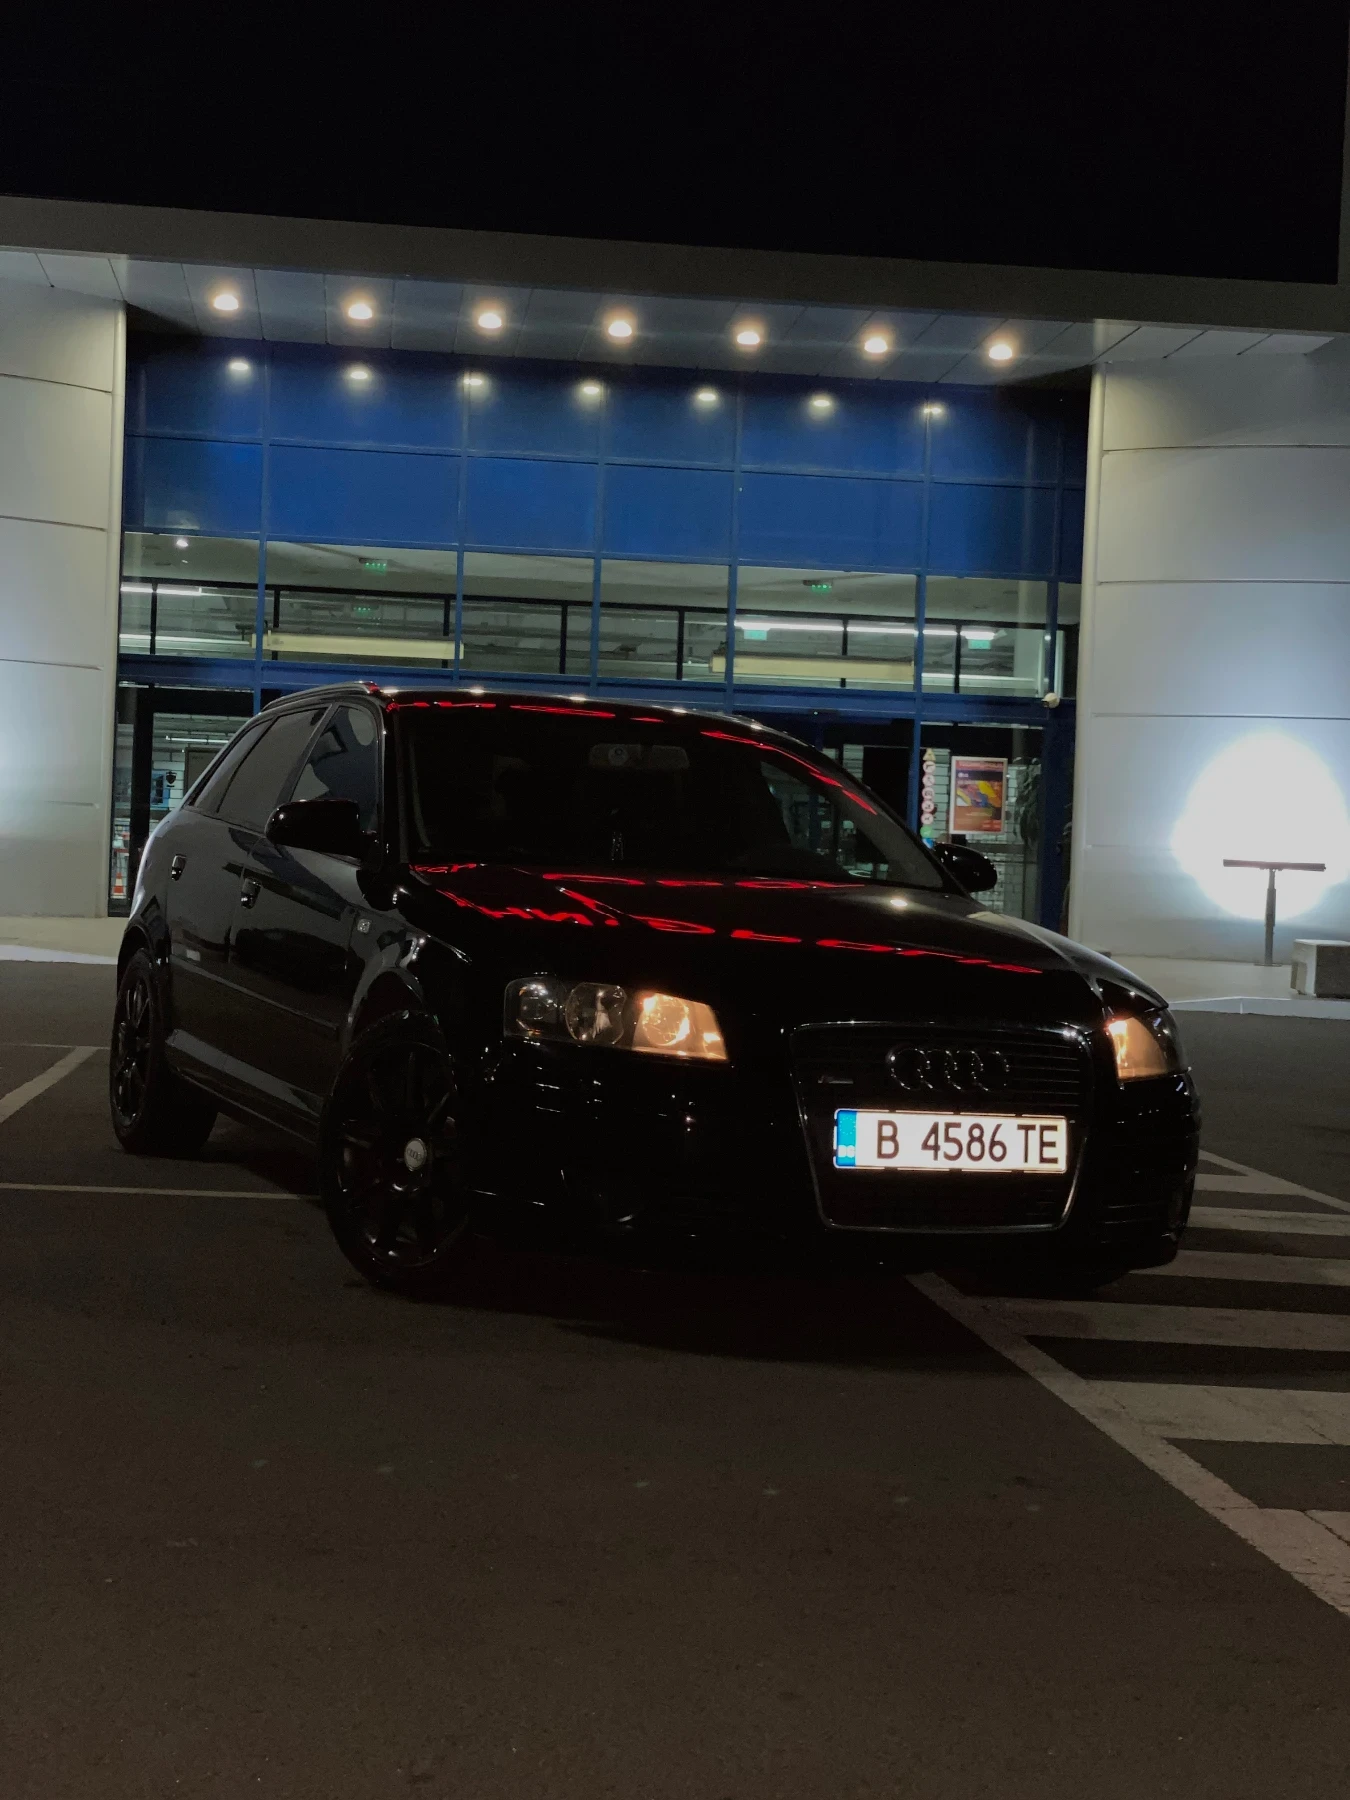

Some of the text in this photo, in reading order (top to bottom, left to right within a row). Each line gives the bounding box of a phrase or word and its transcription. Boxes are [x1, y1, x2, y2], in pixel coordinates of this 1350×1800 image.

[876, 1120, 1059, 1164] B 4586 TE
